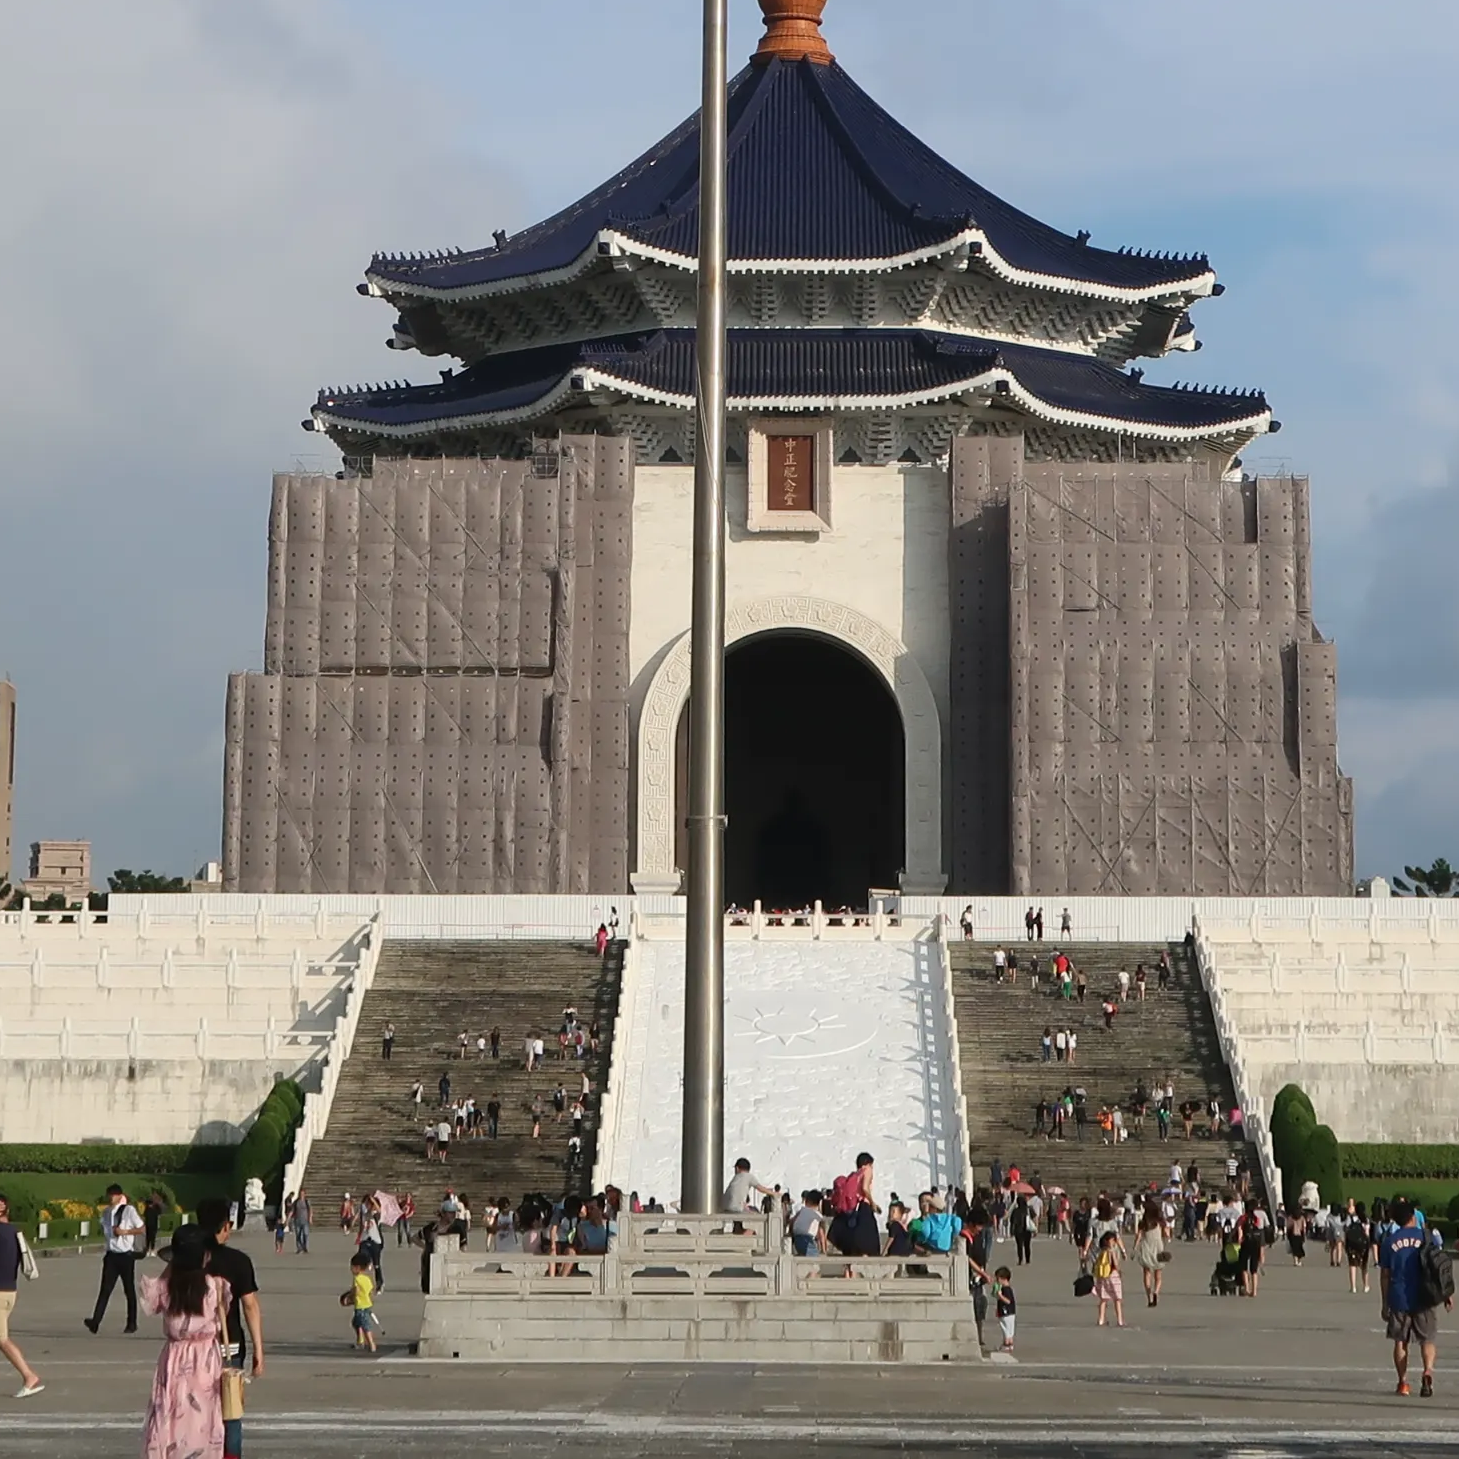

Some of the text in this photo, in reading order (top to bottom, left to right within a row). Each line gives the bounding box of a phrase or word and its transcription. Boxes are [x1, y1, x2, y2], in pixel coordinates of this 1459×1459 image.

[783, 437, 798, 506] 中正紀念堂
